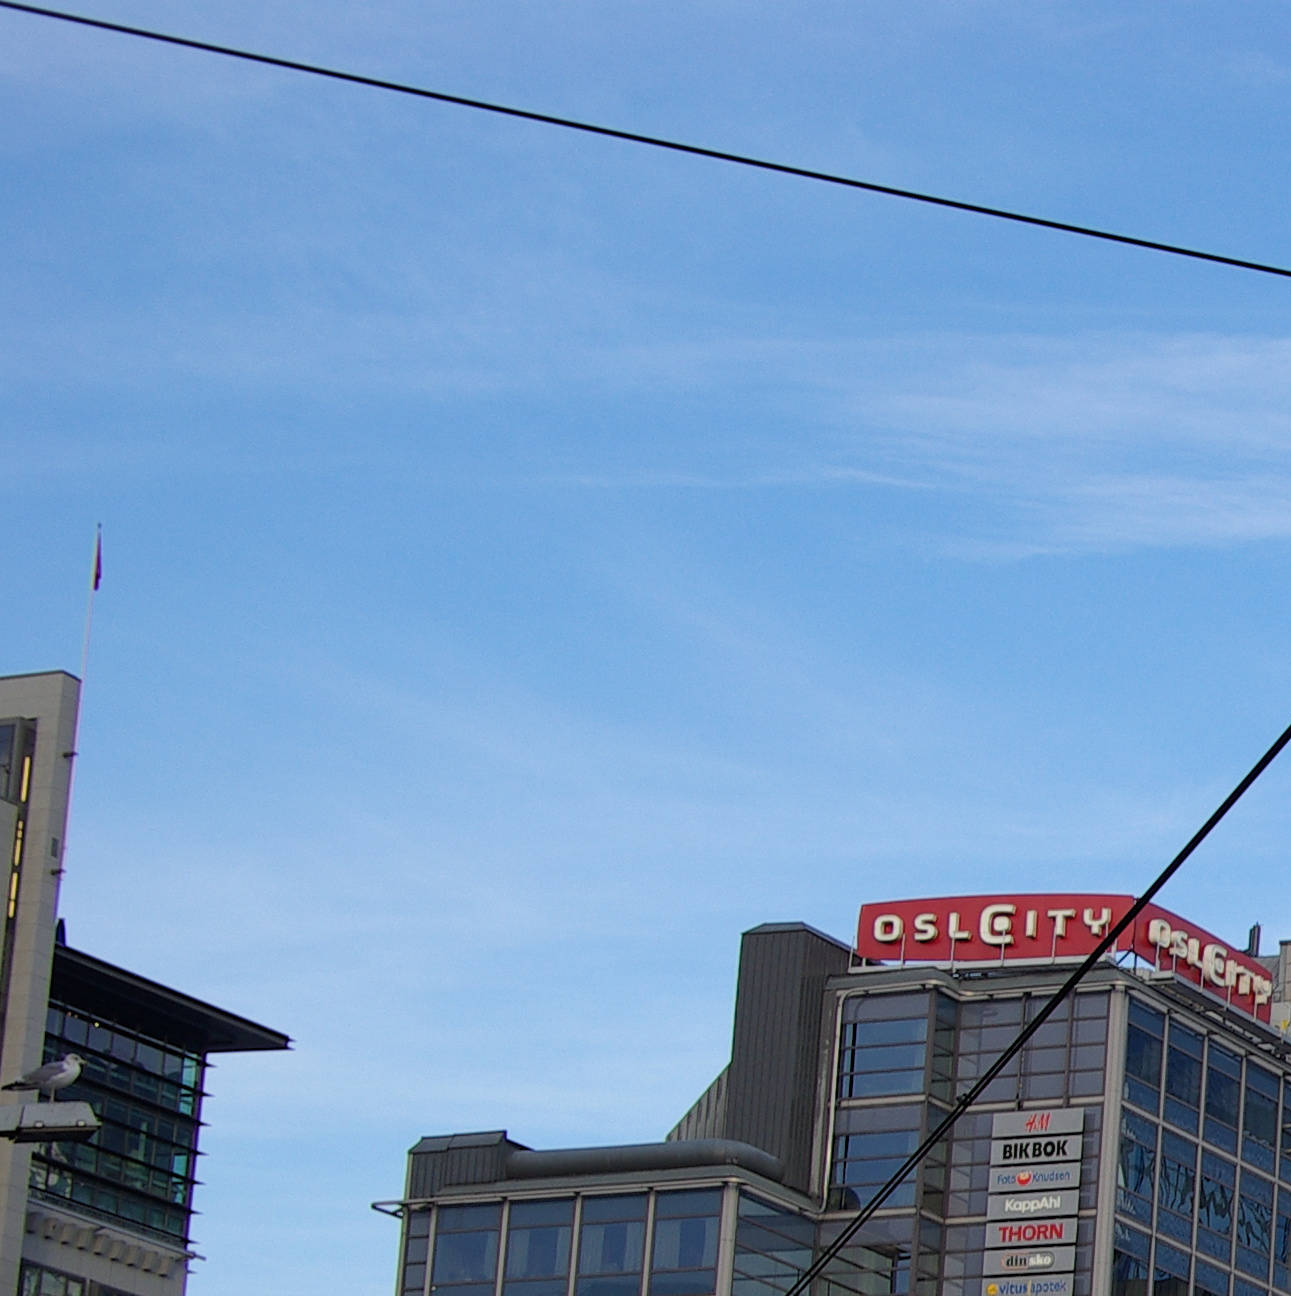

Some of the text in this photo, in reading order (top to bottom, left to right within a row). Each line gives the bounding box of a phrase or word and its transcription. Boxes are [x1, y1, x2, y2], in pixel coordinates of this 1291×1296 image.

[1002, 1140, 1068, 1160] BIK BOK
[997, 1171, 1070, 1185] Foto Knudsen
[1004, 1195, 1061, 1213] KappAhl
[998, 1223, 1064, 1243] THORN
